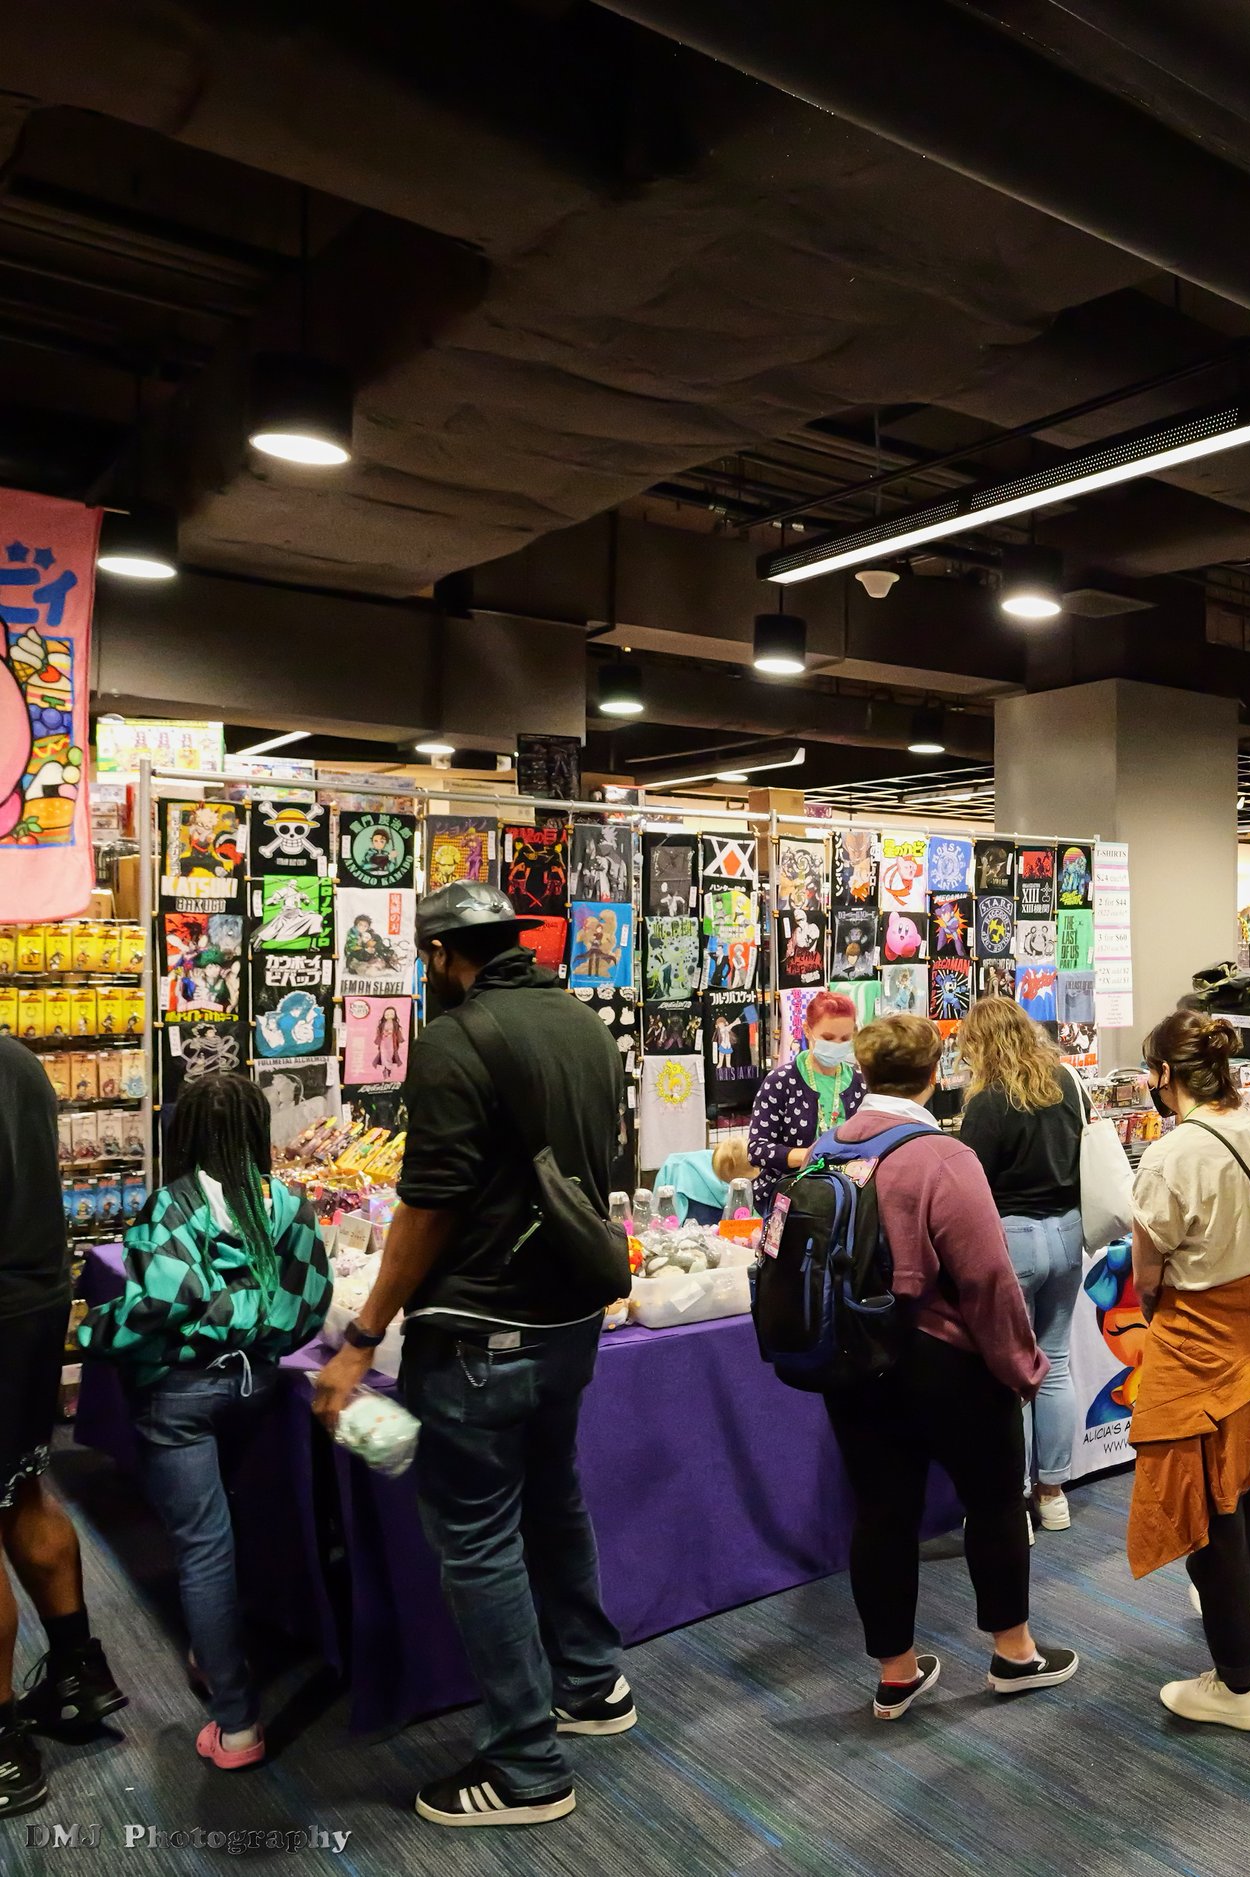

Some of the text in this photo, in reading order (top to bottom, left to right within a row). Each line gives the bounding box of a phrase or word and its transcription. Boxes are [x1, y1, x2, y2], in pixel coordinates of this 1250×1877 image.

[1096, 850, 1127, 858] T-SHIRTS
[161, 875, 238, 898] KATSUKI
[1022, 888, 1040, 903] XIII
[175, 898, 226, 913] BAKUGO
[1063, 915, 1075, 930] THE
[1061, 929, 1078, 945] LAST
[264, 954, 321, 970] カウボーイ
[934, 958, 970, 977] MEGAMAN
[265, 970, 322, 987] ビバップ
[258, 1057, 293, 1066] FULLMETAL
[1083, 1423, 1122, 1445] ALICIA'S
